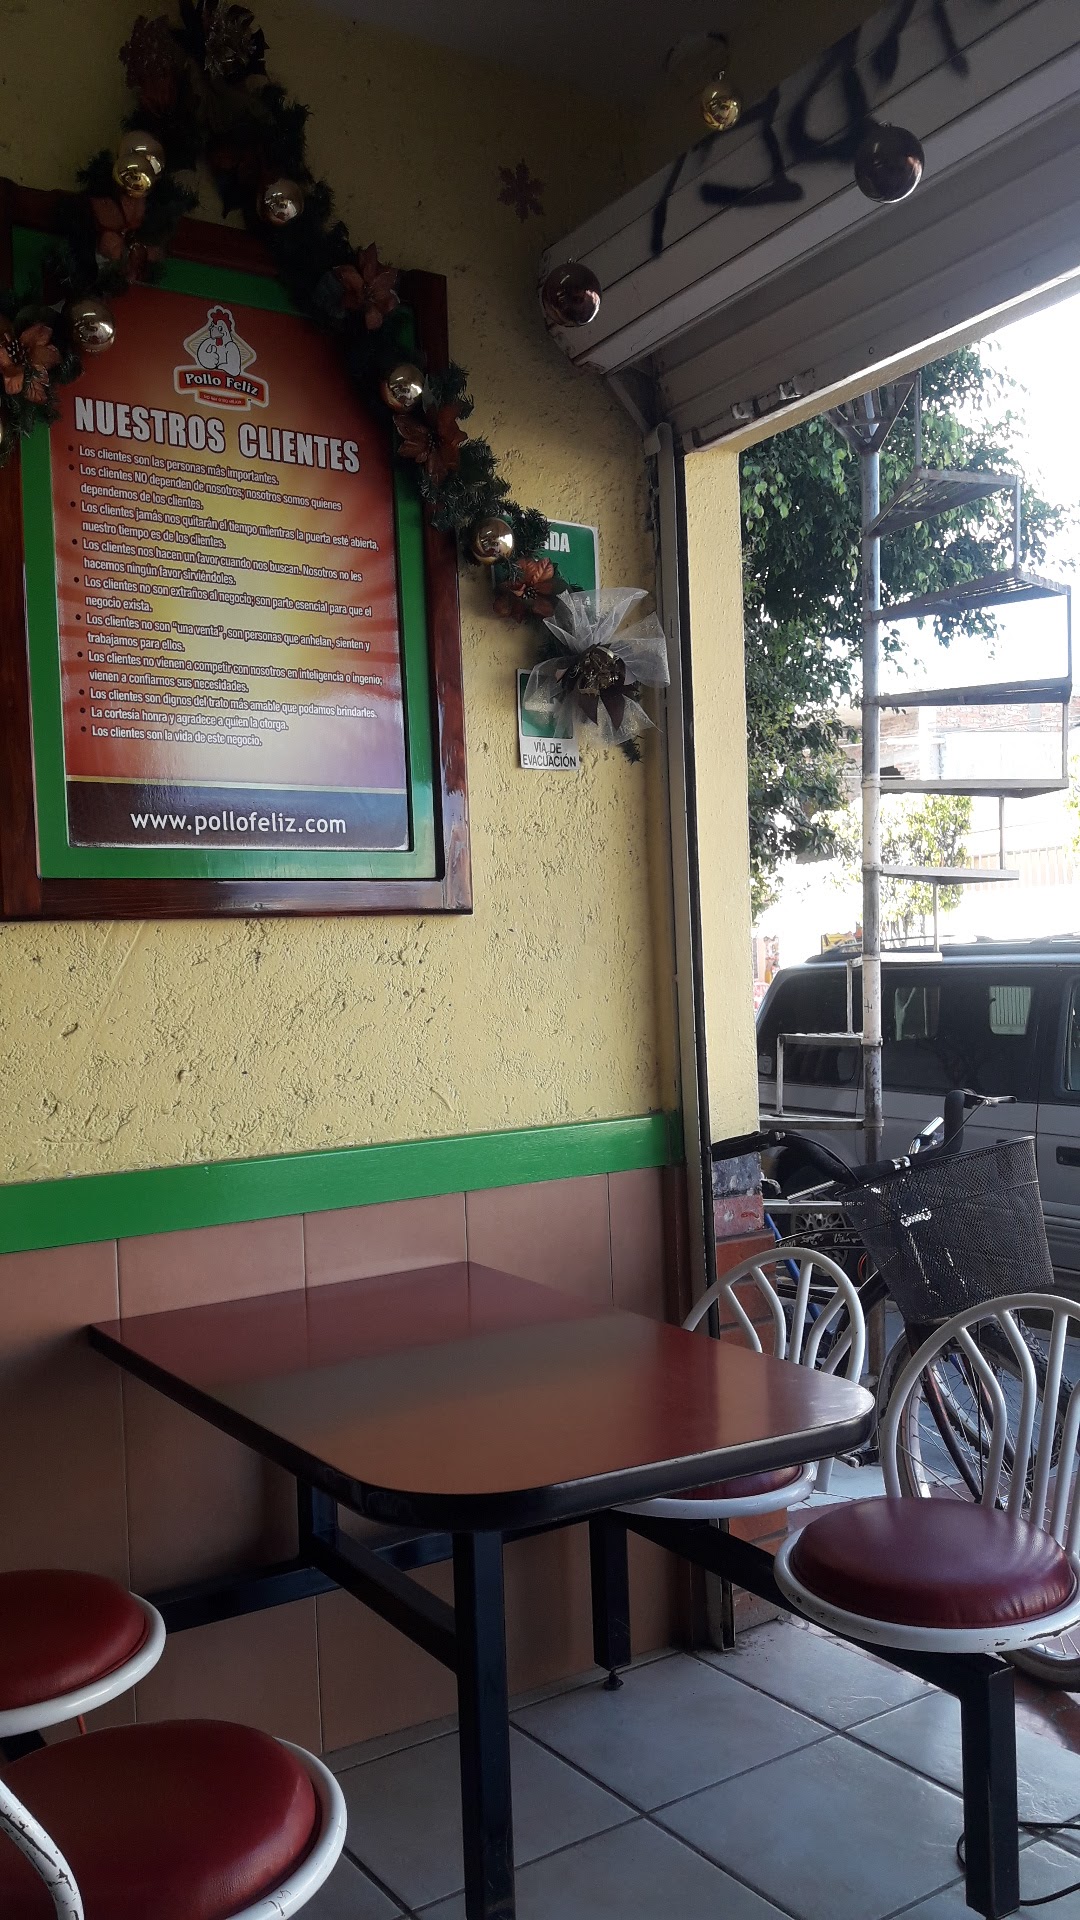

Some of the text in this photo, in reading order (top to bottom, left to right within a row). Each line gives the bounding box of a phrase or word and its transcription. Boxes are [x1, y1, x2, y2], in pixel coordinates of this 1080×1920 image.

[185, 373, 258, 396] Pollo Feliz
[75, 396, 361, 473] NUESTROS CLIENTES
[79, 445, 279, 484] Los clientes son las personas más importantes.
[80, 464, 342, 511] Los clientes NO dependen de nosotros; nosotros somos quienes
[80, 482, 203, 509] dependemos de los clientes.
[82, 501, 379, 552] Los clientes jamás nos quitarán el tiempo mientras la puerta esté abierta,
[82, 522, 226, 548] nuestro tiempo es de los clientes.
[83, 538, 362, 581] Los clientes nos hacen un favor cuando nos buscan. Nosotros no les
[84, 558, 236, 585] hacemos ningún favor sirviéndoles.
[85, 576, 372, 617] Los clientes no son extraños al negocio; son parte esencial para que el
[86, 597, 153, 612] negocio exista.
[86, 614, 103, 626] Los
[104, 616, 139, 629] clientes
[141, 621, 153, 630] no
[154, 622, 171, 632] son
[195, 626, 226, 639] venta”,
[227, 629, 243, 638] son
[244, 630, 282, 642] personas
[283, 634, 298, 645] que
[300, 635, 334, 649] anhelan,
[335, 638, 364, 650] sienten
[87, 633, 185, 651] trabajamos para ellos.
[88, 651, 105, 663] Los
[106, 653, 141, 666] clientes
[143, 657, 155, 667] no
[156, 657, 185, 669] vienen
[194, 662, 233, 674] competir
[233, 665, 249, 674] con
[250, 666, 286, 677] nosotros
[287, 669, 298, 678] en
[299, 668, 344, 682] inteligencia
[352, 673, 383, 687] ingenio;
[89, 670, 119, 682] vienen
[128, 674, 175, 686] confiarnos
[176, 678, 192, 688] sus
[194, 679, 249, 692] necesidades.
[90, 688, 377, 718] Los clientes son dignos del trato más amable que podamos brindarles.
[91, 707, 103, 718] La
[104, 709, 140, 720] cortesía
[142, 710, 168, 722] honra
[176, 713, 216, 725] agradece
[225, 716, 248, 728] quien
[250, 717, 258, 728] la
[259, 718, 289, 731] otorga.
[92, 725, 262, 747] Los clientes son la vida de este negocio.
[534, 739, 562, 754] VÍA DE
[523, 753, 577, 767] EVACUACIÓN
[130, 811, 347, 836] www.pollofeliz.com
